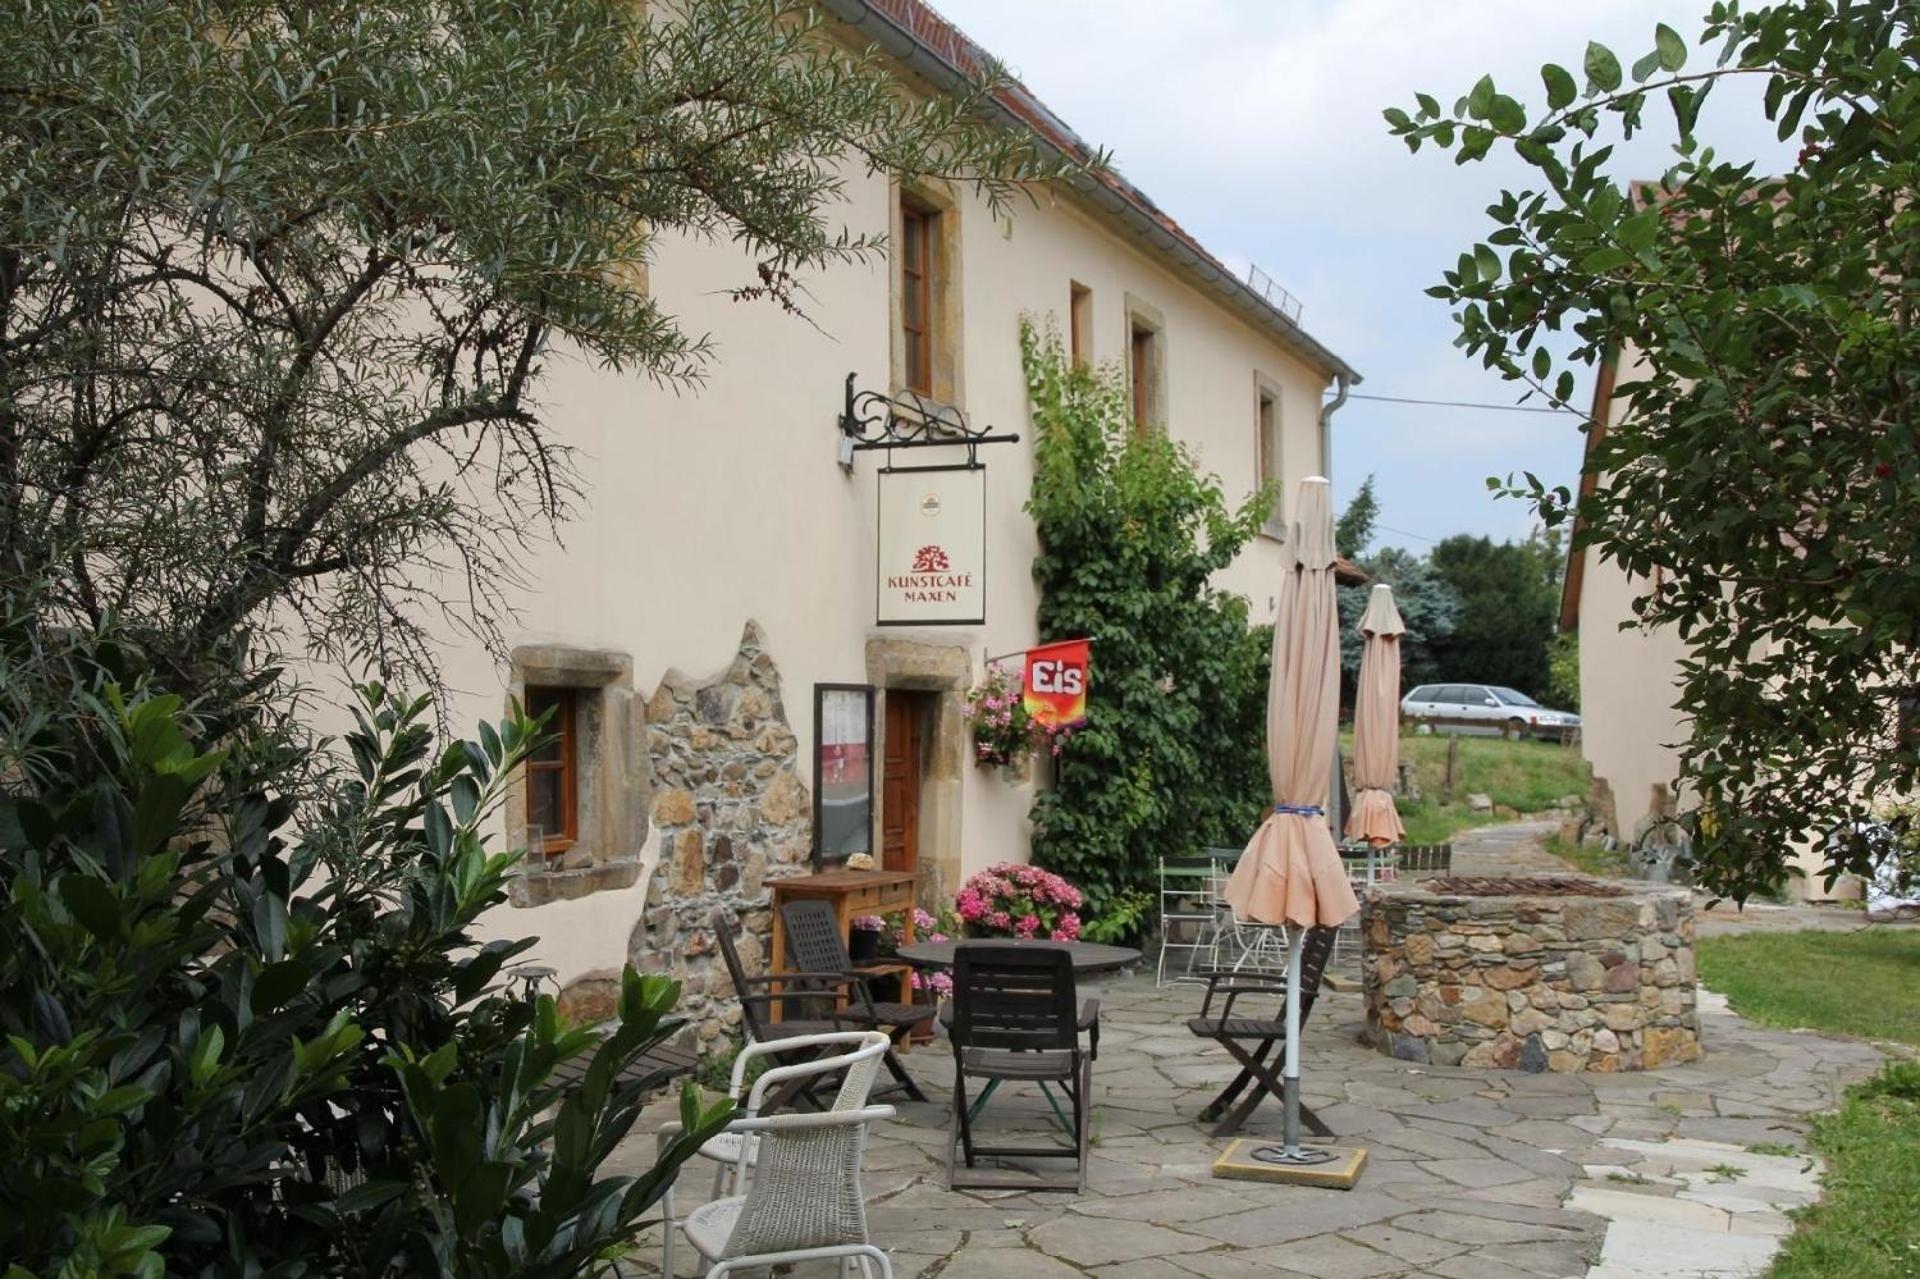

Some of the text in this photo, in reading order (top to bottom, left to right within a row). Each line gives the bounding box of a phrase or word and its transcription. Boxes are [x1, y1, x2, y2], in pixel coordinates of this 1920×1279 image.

[887, 572, 973, 589] KUNSTCAFÉ
[904, 591, 956, 602] MAXEN
[1032, 659, 1082, 695] Eis
